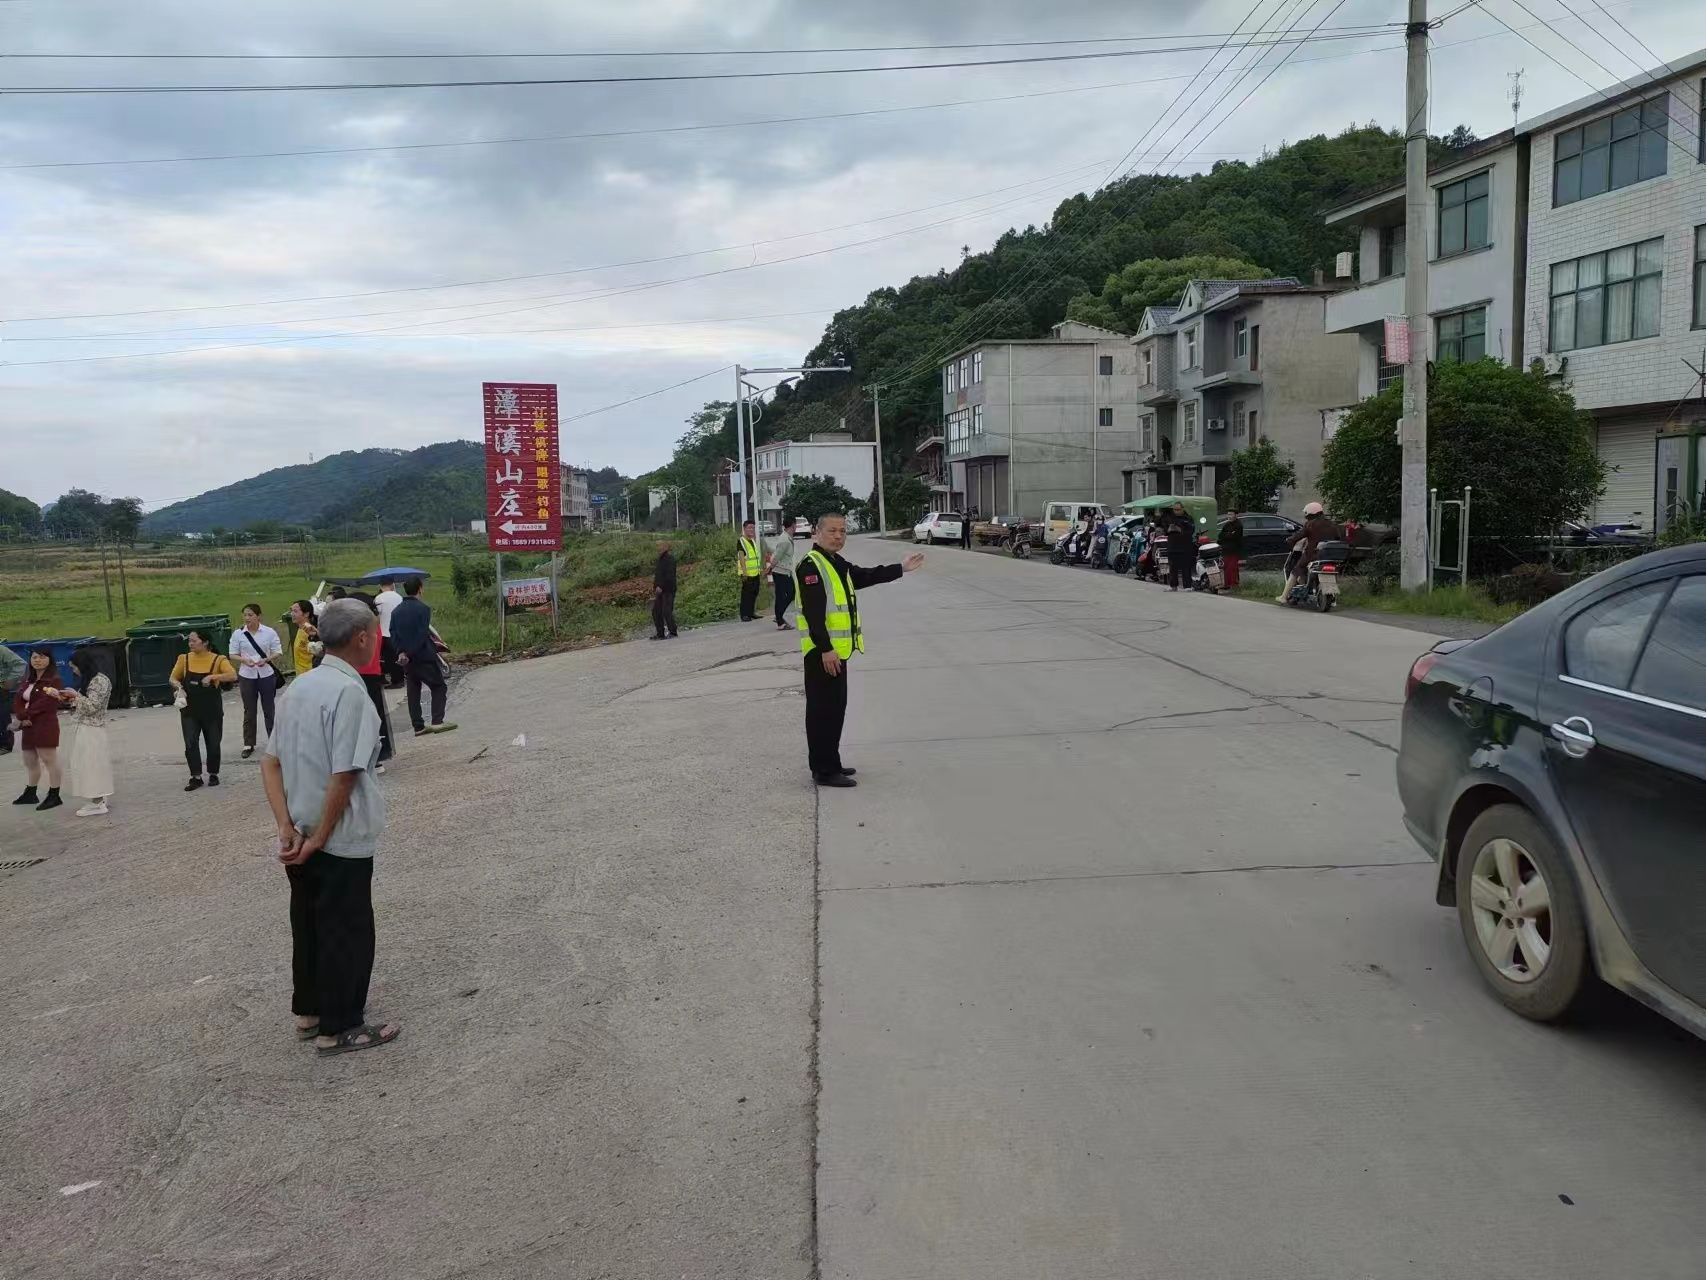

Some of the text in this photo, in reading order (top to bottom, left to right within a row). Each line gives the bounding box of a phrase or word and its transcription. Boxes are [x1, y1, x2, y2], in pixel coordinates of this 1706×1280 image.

[535, 437, 549, 461] 棋牌
[536, 466, 549, 490] 唱歌
[537, 495, 549, 519] 钓鱼
